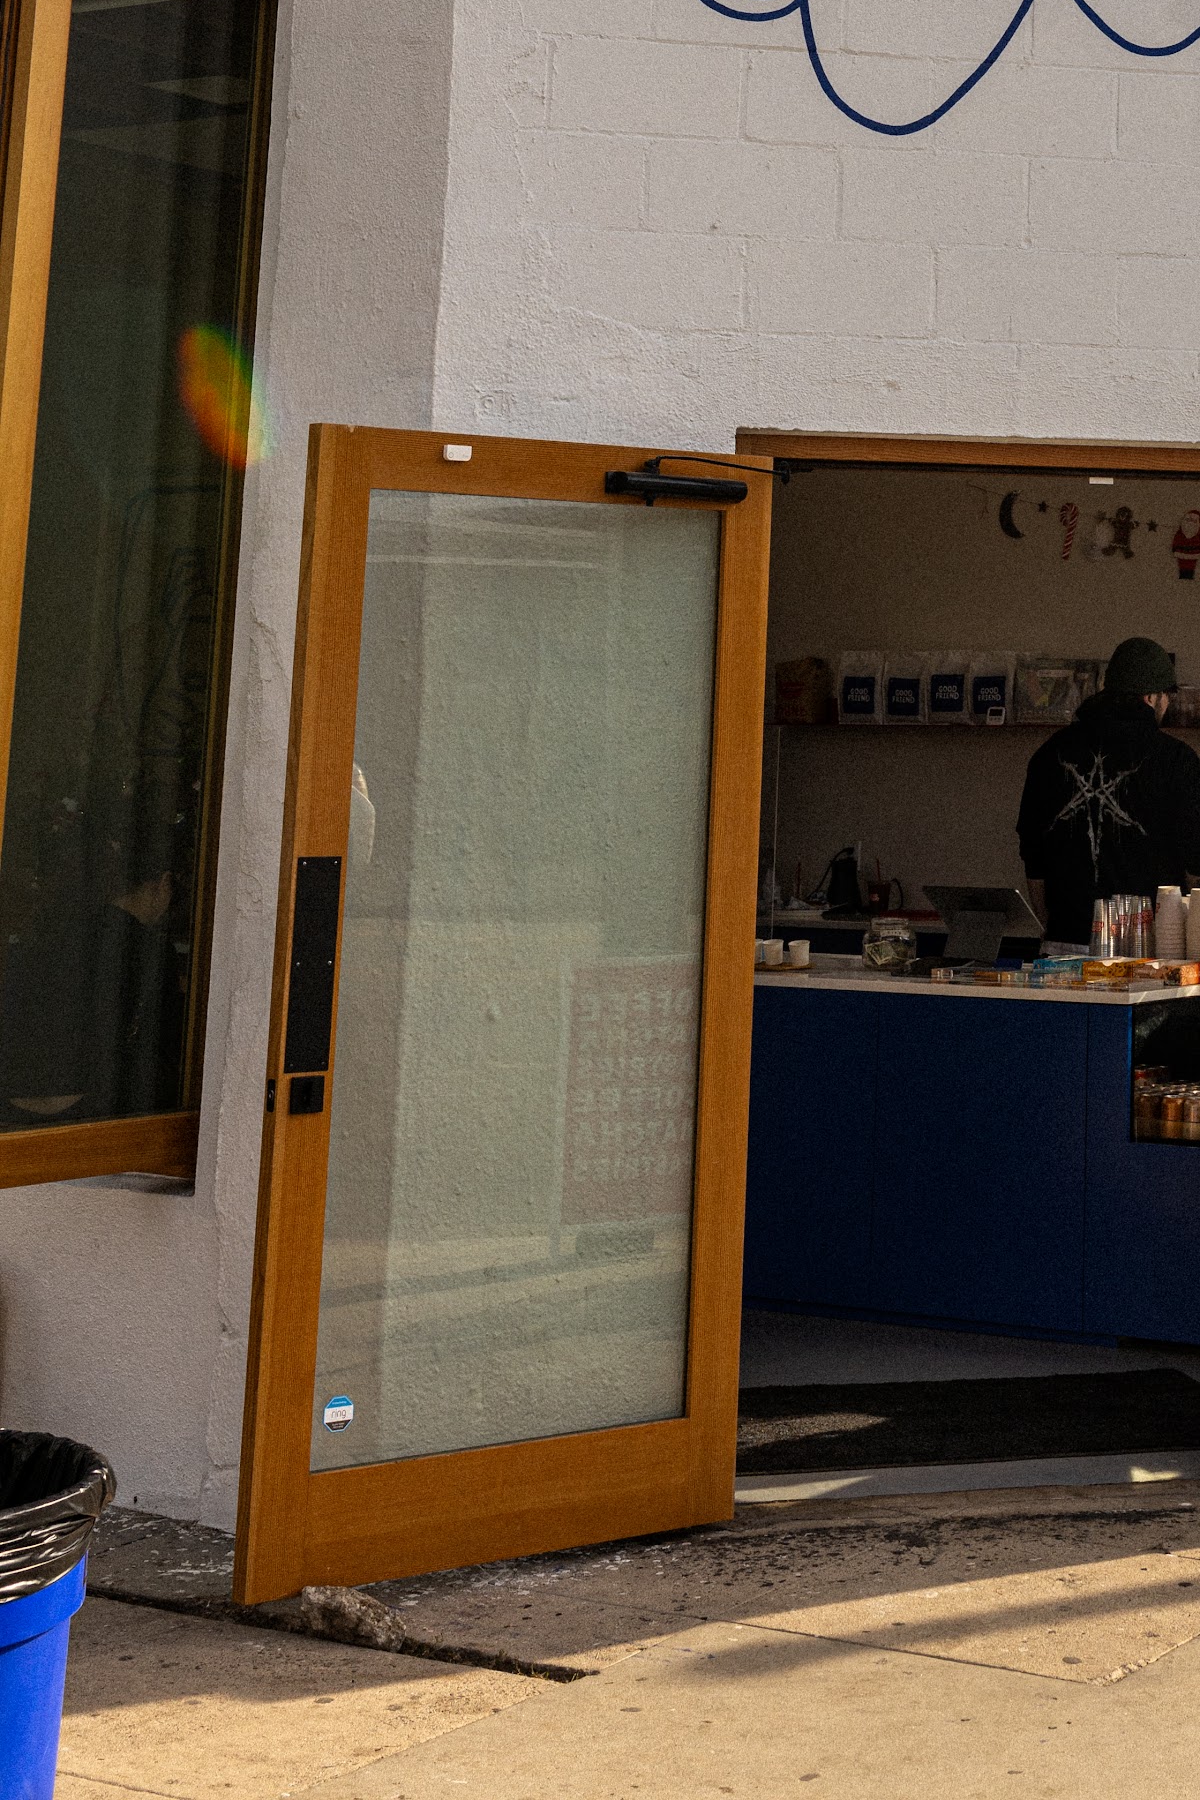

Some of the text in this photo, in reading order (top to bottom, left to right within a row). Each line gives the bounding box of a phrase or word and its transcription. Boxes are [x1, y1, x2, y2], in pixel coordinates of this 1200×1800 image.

[938, 685, 958, 693] GOOD
[980, 687, 999, 695] GOOD
[847, 694, 871, 702] FRIEND
[892, 696, 915, 704] FRIEND
[935, 692, 960, 700] FRIEND
[977, 694, 1002, 702] FRIEND
[331, 1408, 347, 1419] ring
